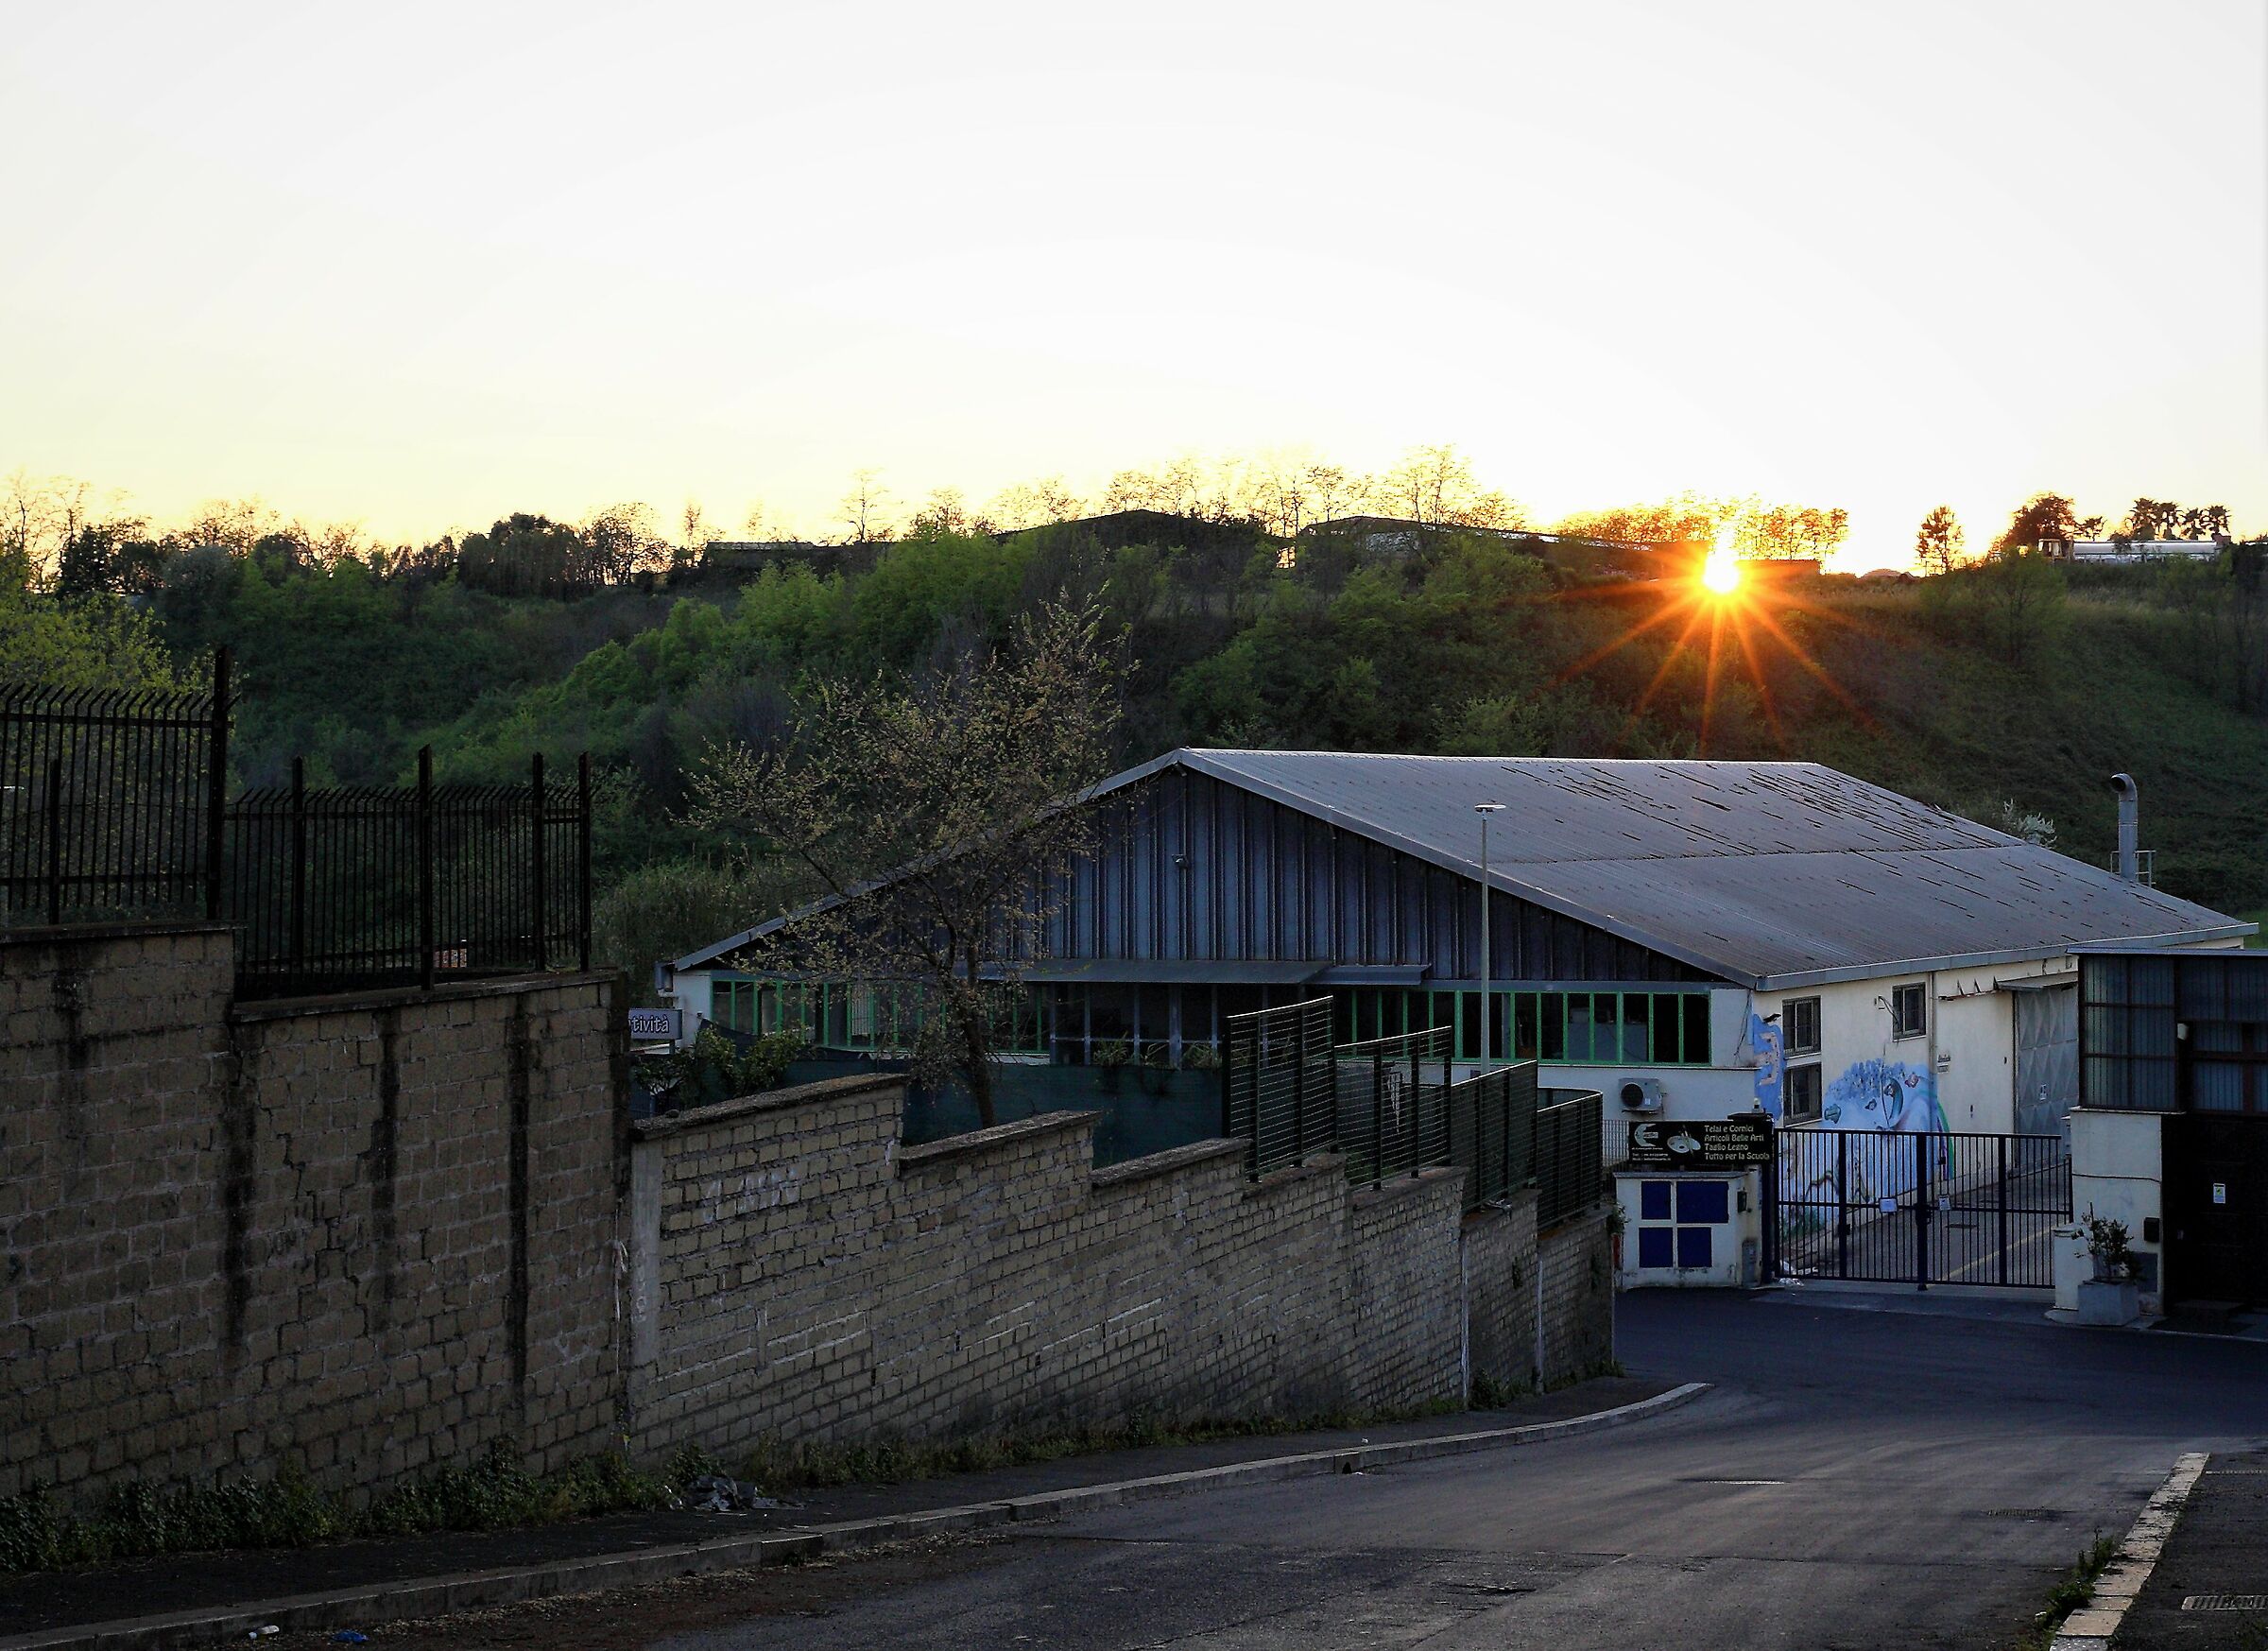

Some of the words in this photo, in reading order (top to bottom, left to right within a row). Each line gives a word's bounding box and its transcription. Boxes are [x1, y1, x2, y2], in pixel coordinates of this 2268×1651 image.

[628, 1014, 670, 1034] tività
[1729, 1124, 1754, 1133] Cornici
[1704, 1133, 1730, 1142] Articoli
[1731, 1133, 1749, 1142] Belle
[1750, 1133, 1764, 1142] Arti
[1704, 1152, 1724, 1161] Tutto
[1725, 1153, 1737, 1161] per
[1738, 1152, 1745, 1161] la
[1746, 1152, 1770, 1161] Scuola
